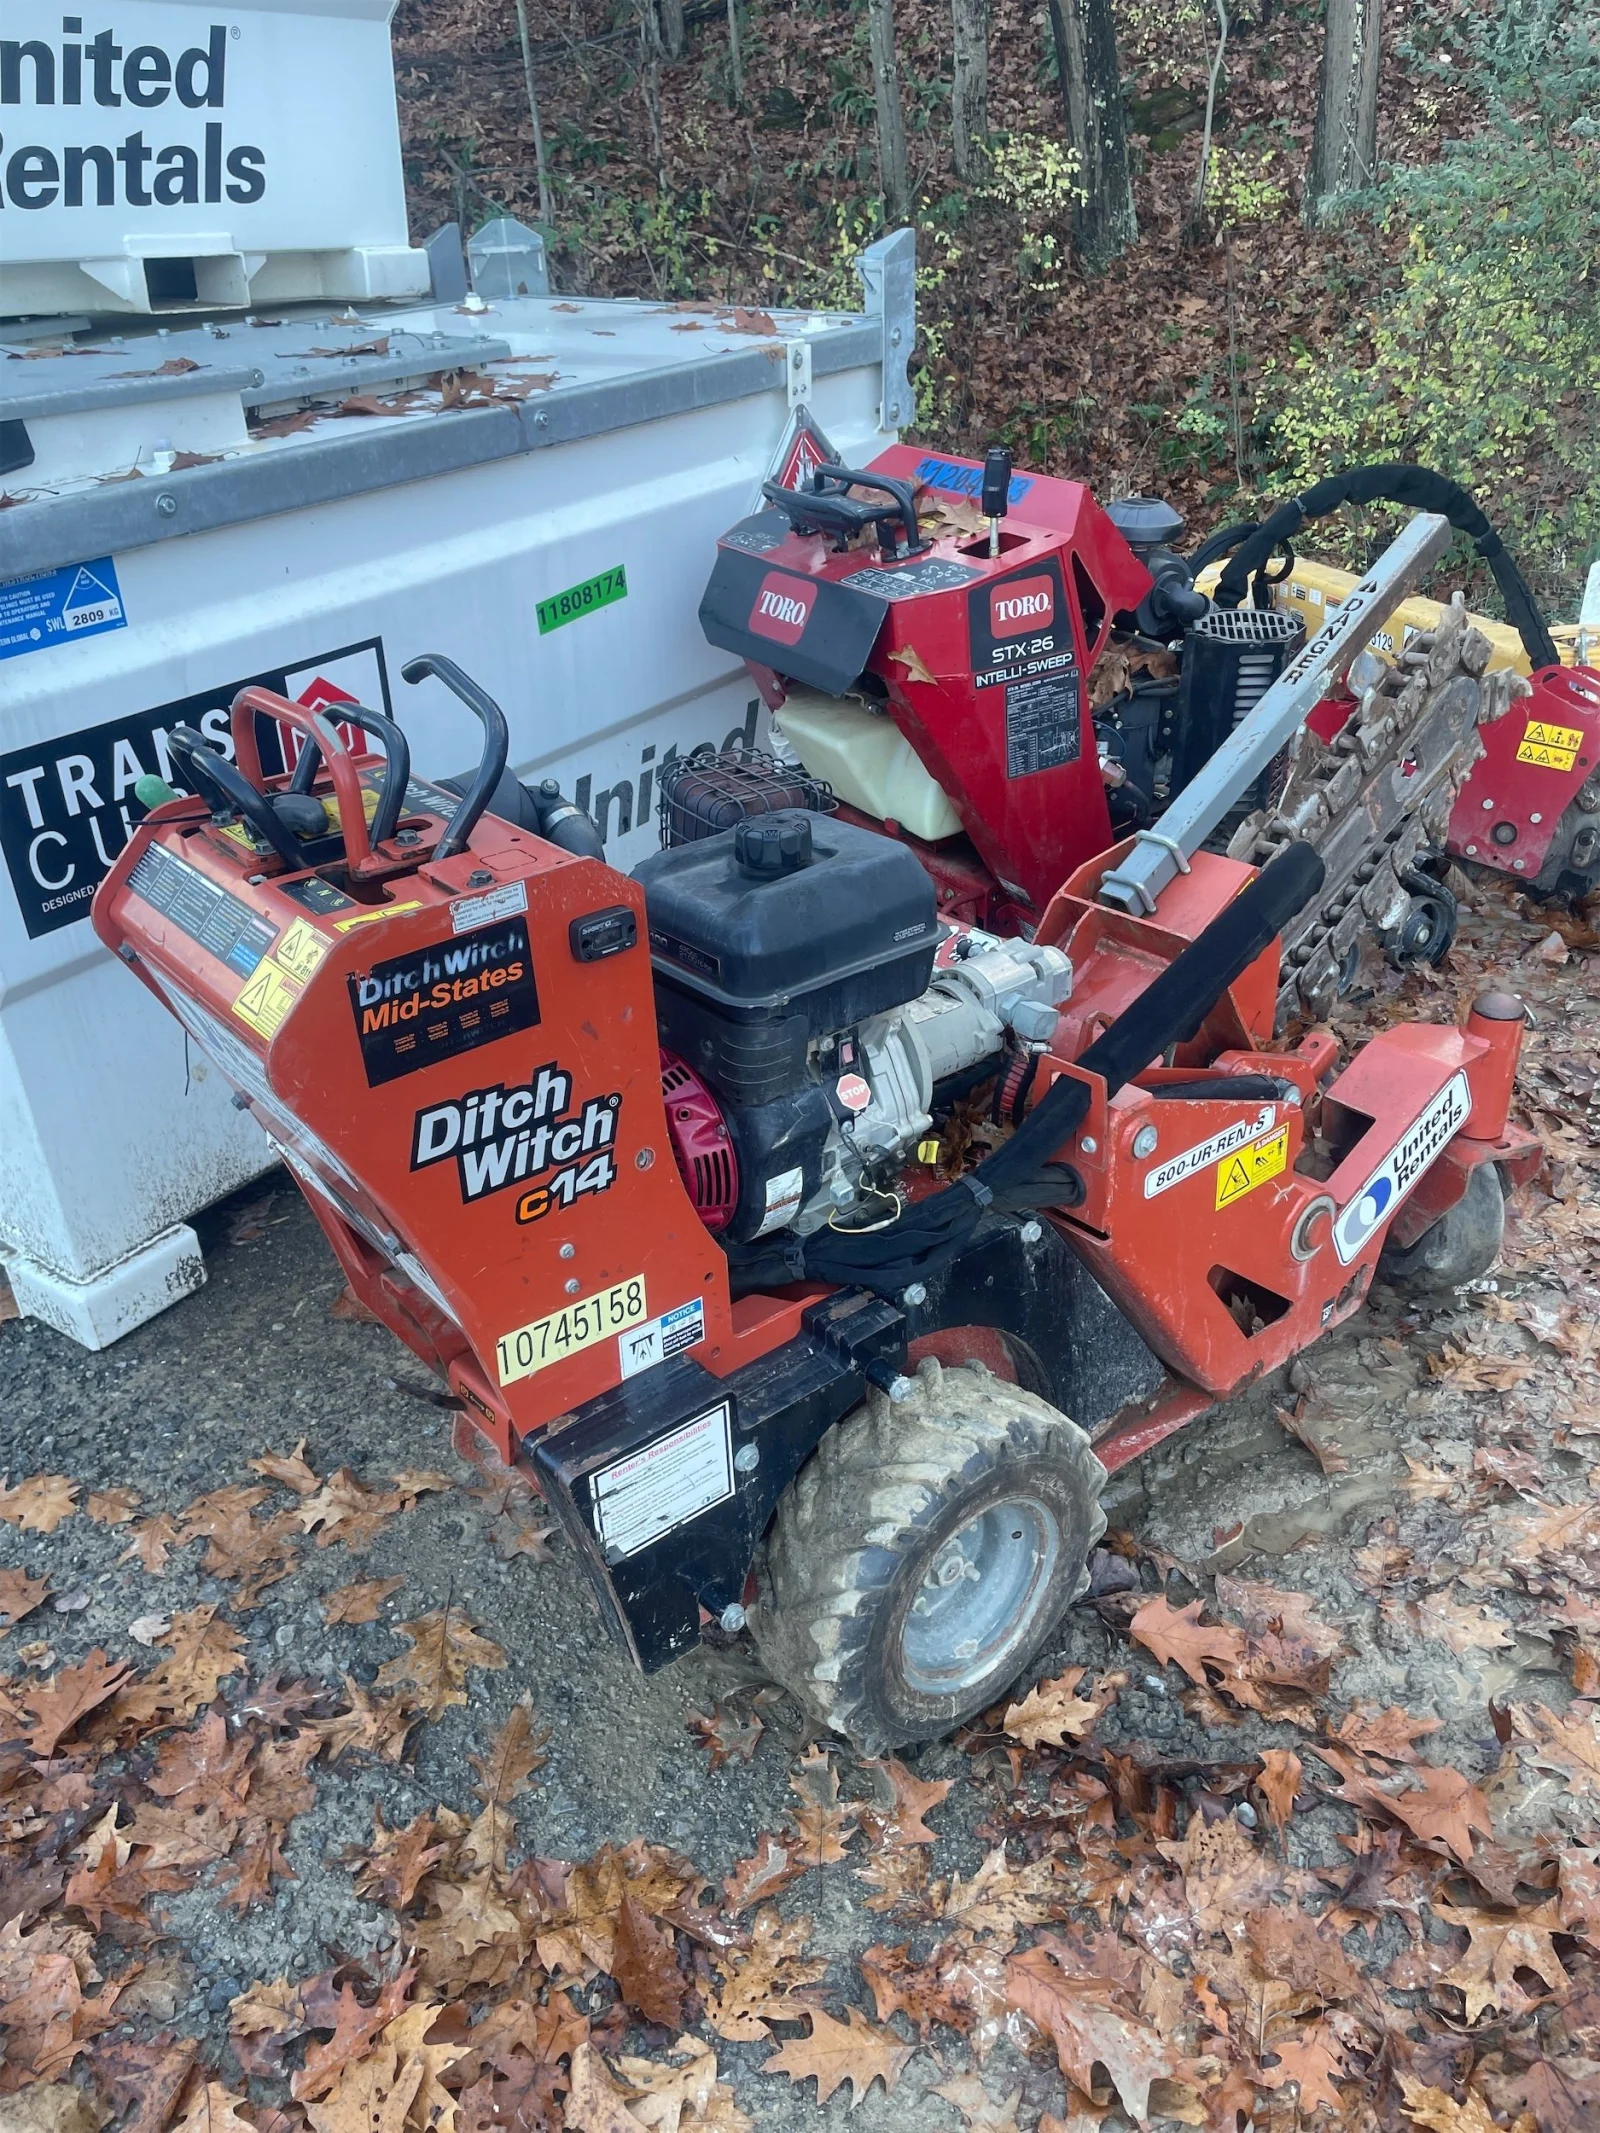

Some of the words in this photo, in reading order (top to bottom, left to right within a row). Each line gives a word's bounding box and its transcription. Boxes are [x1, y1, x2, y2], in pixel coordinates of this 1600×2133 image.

[0, 122, 266, 209] entals
[9, 590, 31, 600] CAUTION
[11, 603, 39, 615] OPERATORS
[19, 597, 33, 606] MUST
[42, 592, 55, 600] USED
[538, 569, 625, 626] 11808174
[758, 590, 806, 625] TORO
[995, 592, 1050, 621] TORO
[25, 610, 46, 620] MANUAL
[46, 616, 65, 632] SWL
[72, 610, 104, 626] 2809
[108, 607, 119, 616] KG
[11, 633, 29, 644] GLOBAL
[1282, 598, 1364, 685] DANGER
[976, 652, 1073, 687] INTELLI-SWEEP
[42, 884, 95, 913] DESIGNED
[359, 958, 440, 1007] Ditch
[444, 931, 524, 976] Witch
[362, 961, 523, 1035] Mid-States
[841, 1083, 866, 1101] STOP
[415, 1069, 568, 1165] Ditch
[1393, 1089, 1453, 1173] United
[462, 1105, 613, 1197] Witch
[1260, 1127, 1286, 1147] DANGER
[1397, 1104, 1463, 1191] Rentals
[519, 1154, 613, 1221] C14
[497, 1281, 643, 1375] 10745158
[667, 1304, 696, 1323] NOTICE
[611, 1457, 646, 1480] Renter's
[648, 1420, 712, 1460] Responsibilities
